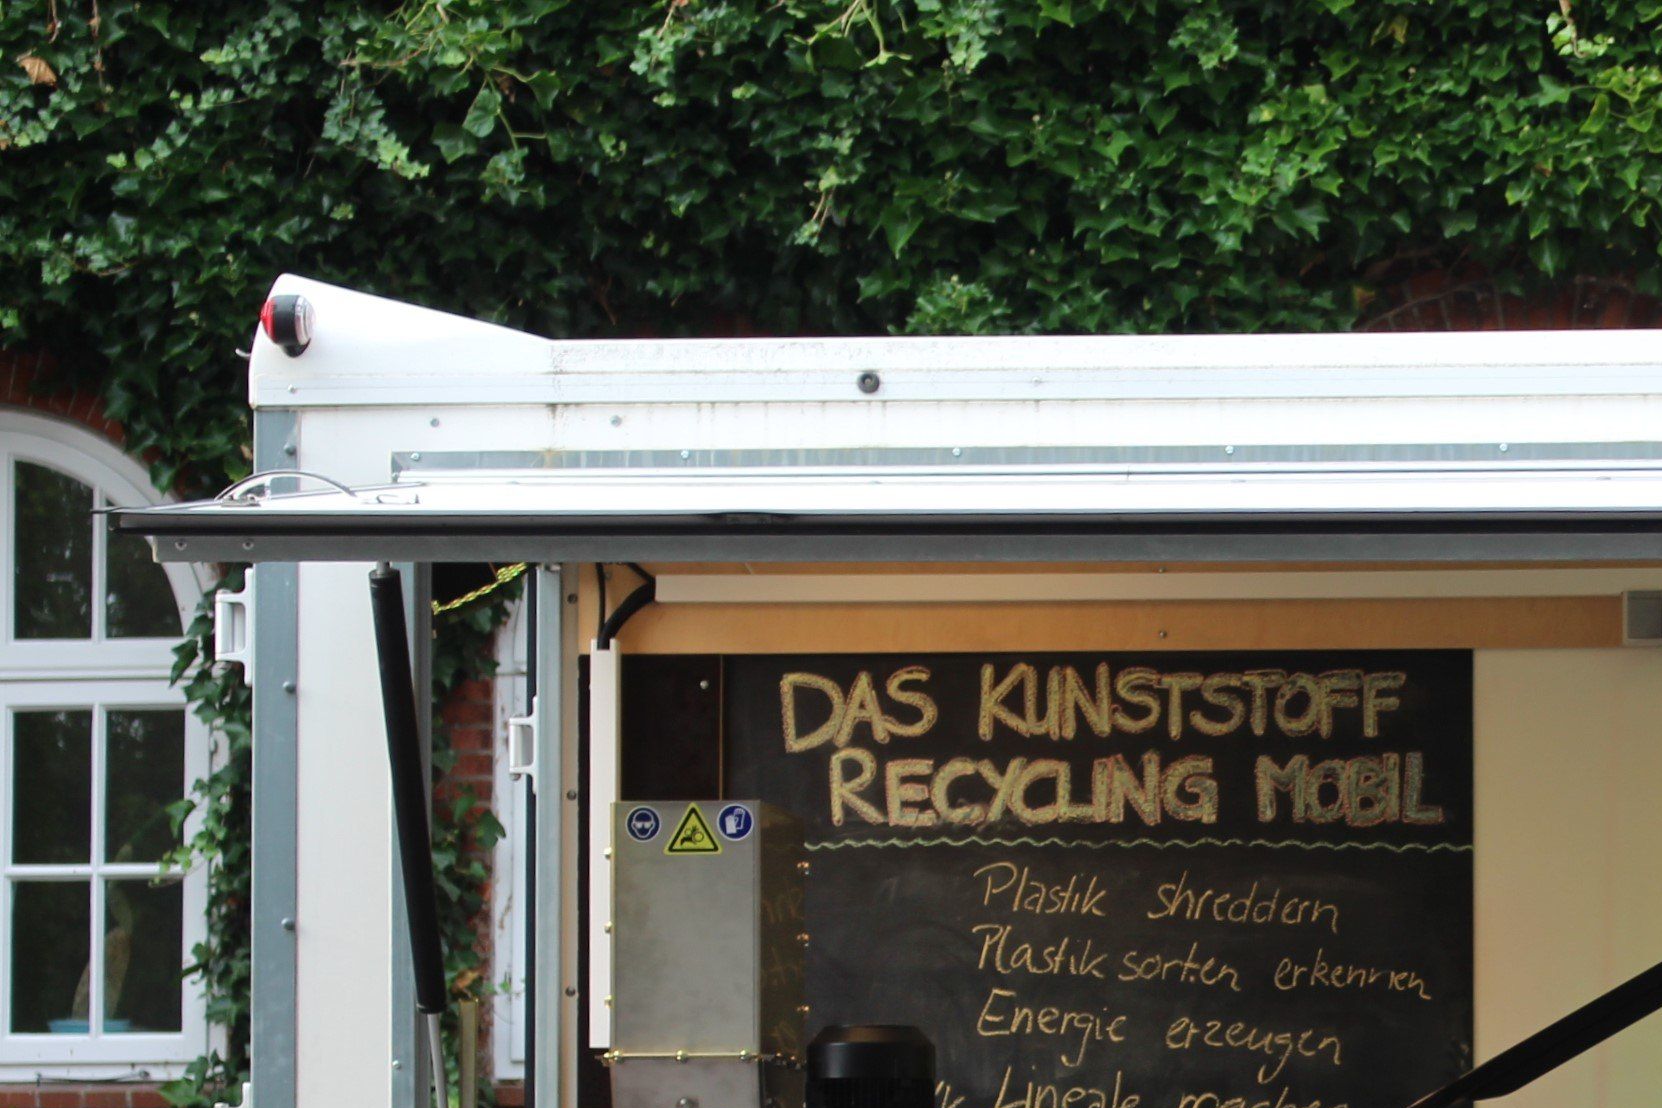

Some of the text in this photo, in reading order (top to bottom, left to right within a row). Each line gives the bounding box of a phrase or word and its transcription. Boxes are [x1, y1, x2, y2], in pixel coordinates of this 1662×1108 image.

[780, 662, 1407, 755] DAS KUNSTSTOFF
[829, 745, 1445, 828] RECYCLING MOBIL
[973, 861, 1339, 934] Plastik shreddern
[1273, 947, 1433, 1001] erkennen
[976, 988, 1342, 1085] Energie erzeugen
